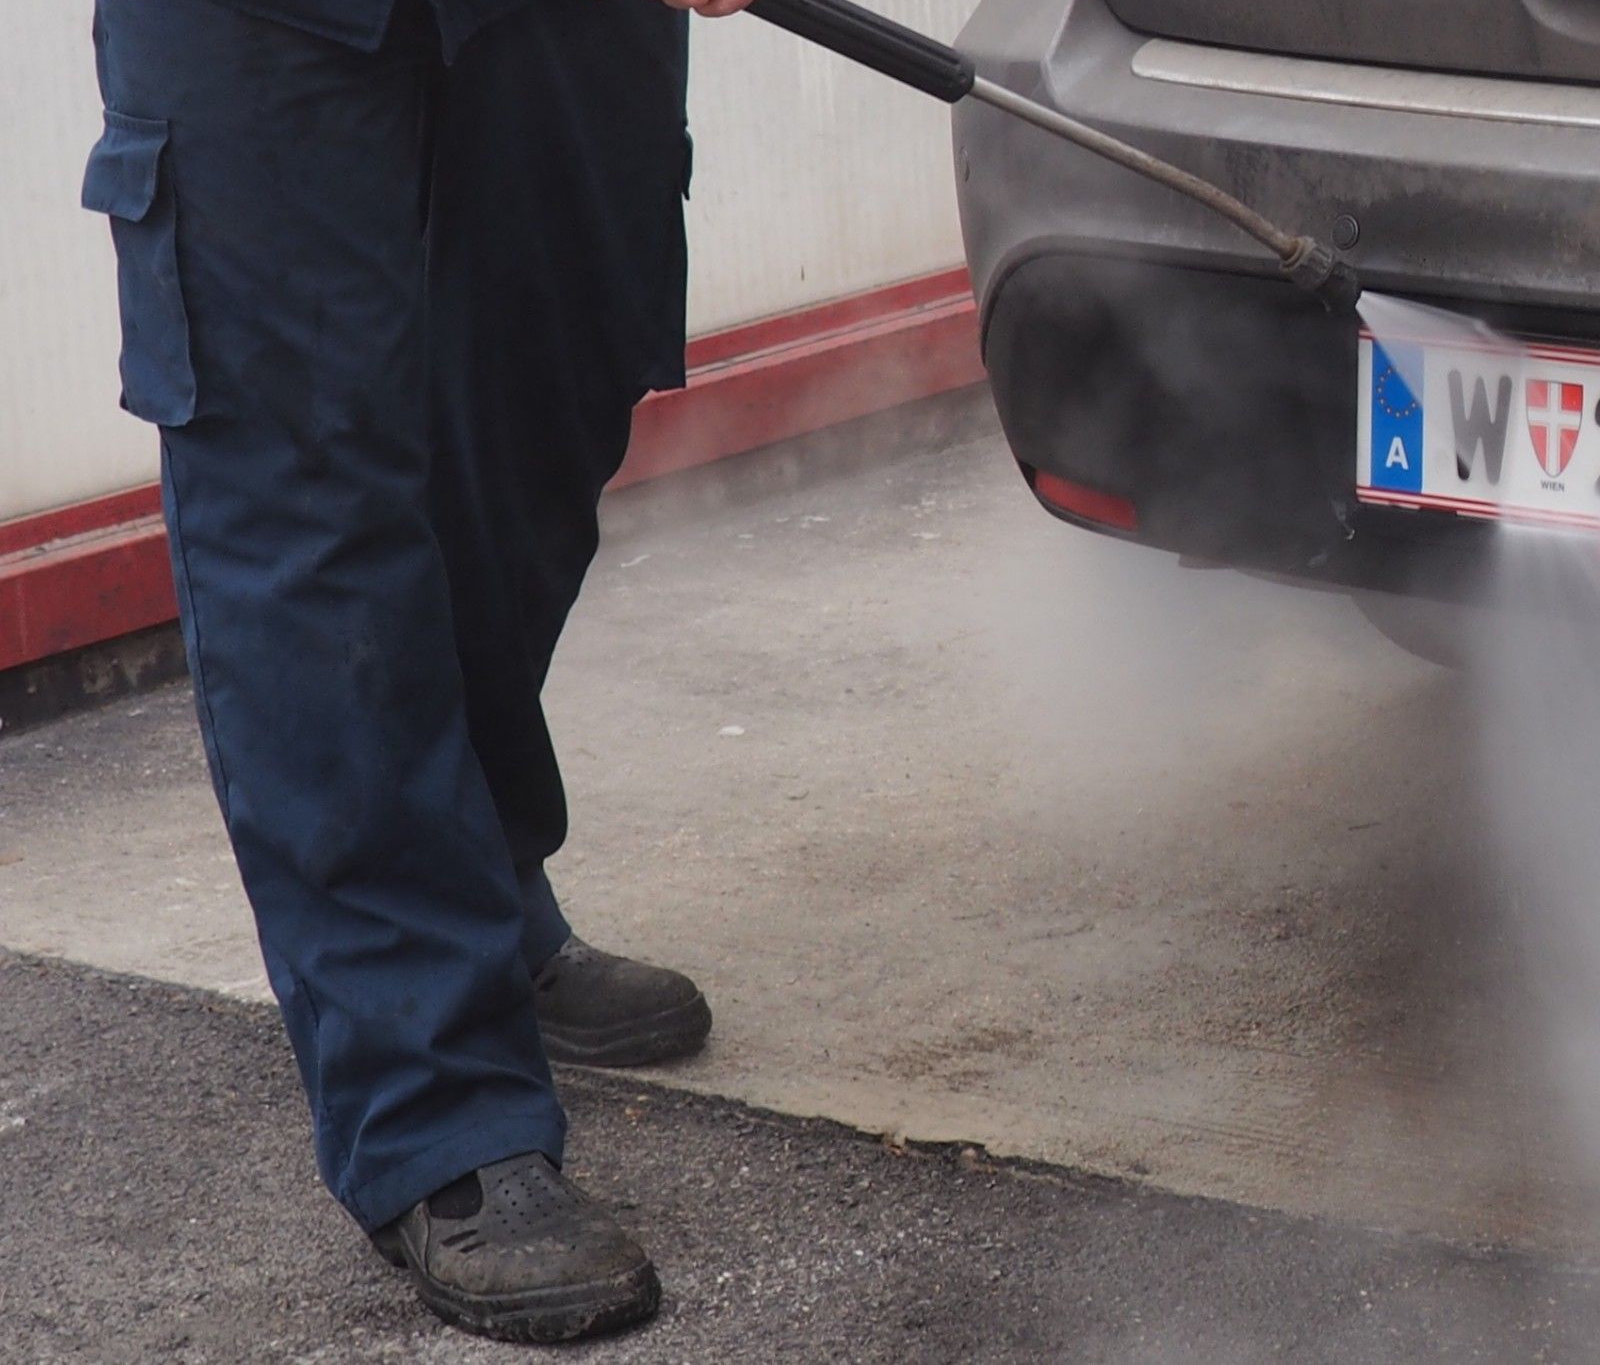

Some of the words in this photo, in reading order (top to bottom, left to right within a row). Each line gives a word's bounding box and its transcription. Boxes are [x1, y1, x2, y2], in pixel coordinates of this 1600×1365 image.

[1447, 369, 1513, 486] W
[1385, 436, 1409, 470] A
[1540, 480, 1565, 492] WIEN
